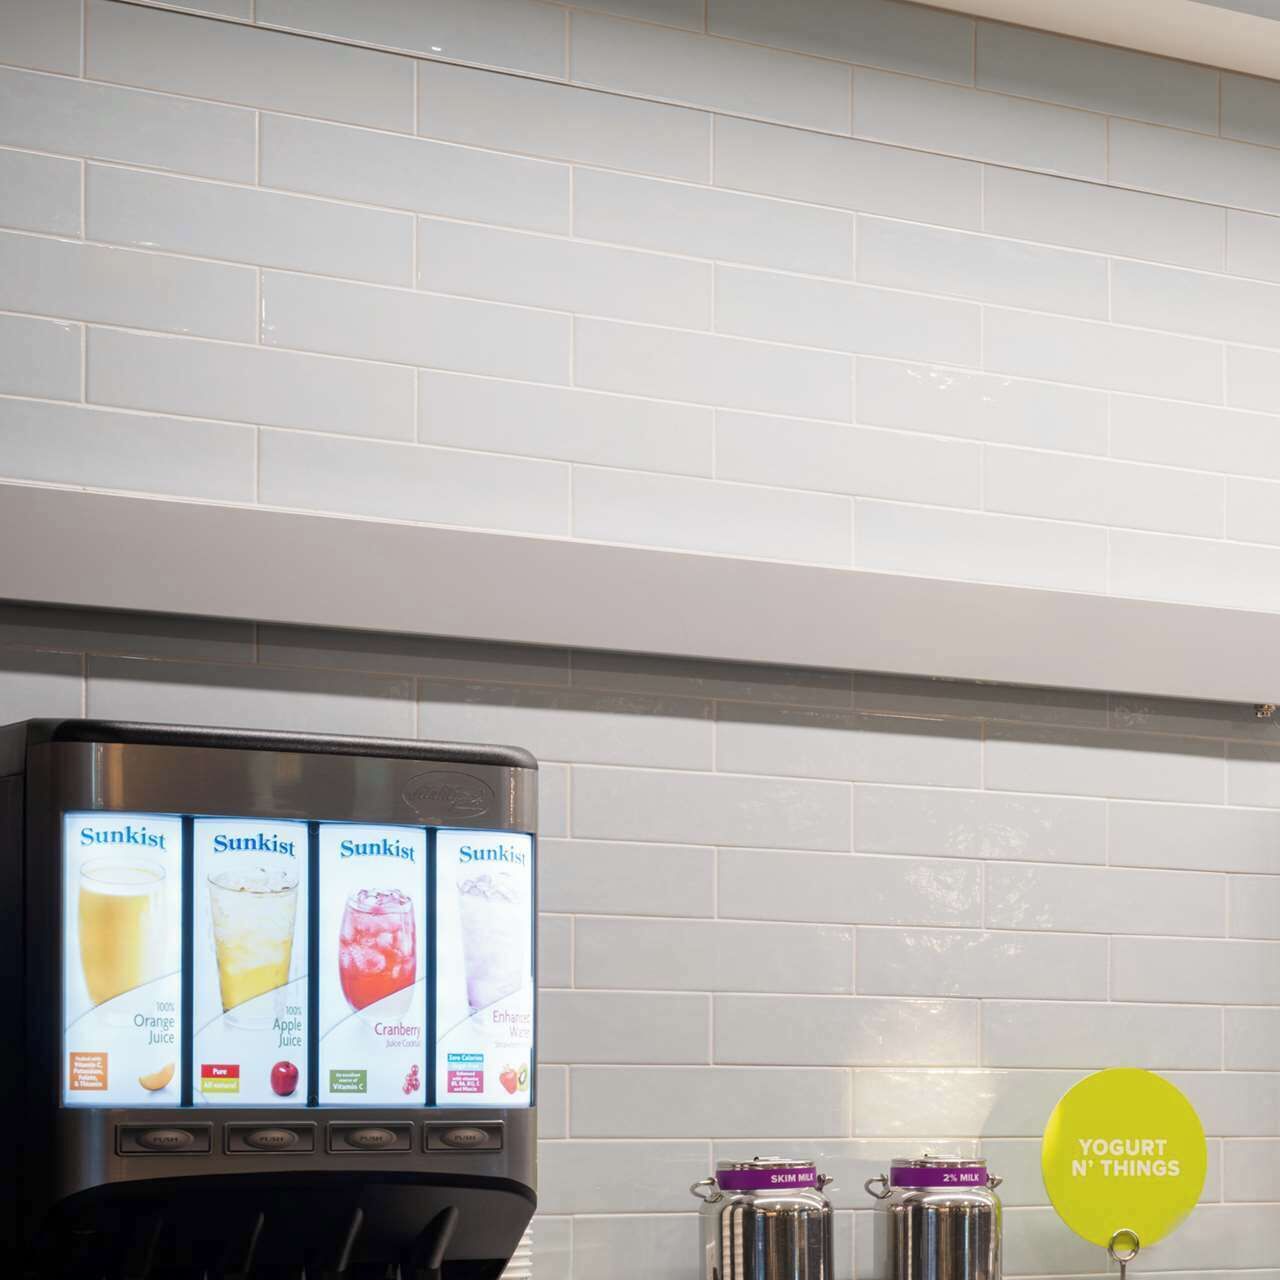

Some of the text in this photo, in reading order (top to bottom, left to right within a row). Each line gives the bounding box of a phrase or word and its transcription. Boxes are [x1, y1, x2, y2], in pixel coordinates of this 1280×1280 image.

[80, 826, 167, 851] Sunkist
[214, 833, 296, 858] Sunkist
[340, 838, 416, 863] Sunkist
[459, 845, 526, 866] Sunkist
[156, 1001, 175, 1013] 100%
[133, 1013, 175, 1032] Orange
[272, 1018, 302, 1035] Apple
[148, 1030, 175, 1046] Juice
[374, 1022, 421, 1040] Cranberry
[278, 1033, 302, 1049] Juice
[212, 1068, 228, 1076] Pure
[153, 1135, 179, 1143] PUSH
[260, 1135, 284, 1143] PUSH
[359, 1134, 383, 1143] PUSH
[454, 1133, 476, 1142] PUSH
[1078, 1138, 1168, 1157] YOGURT
[1071, 1159, 1180, 1178] N' THINGS
[771, 1172, 814, 1184] SKIM MILK
[943, 1174, 980, 1183] 2% MILK
